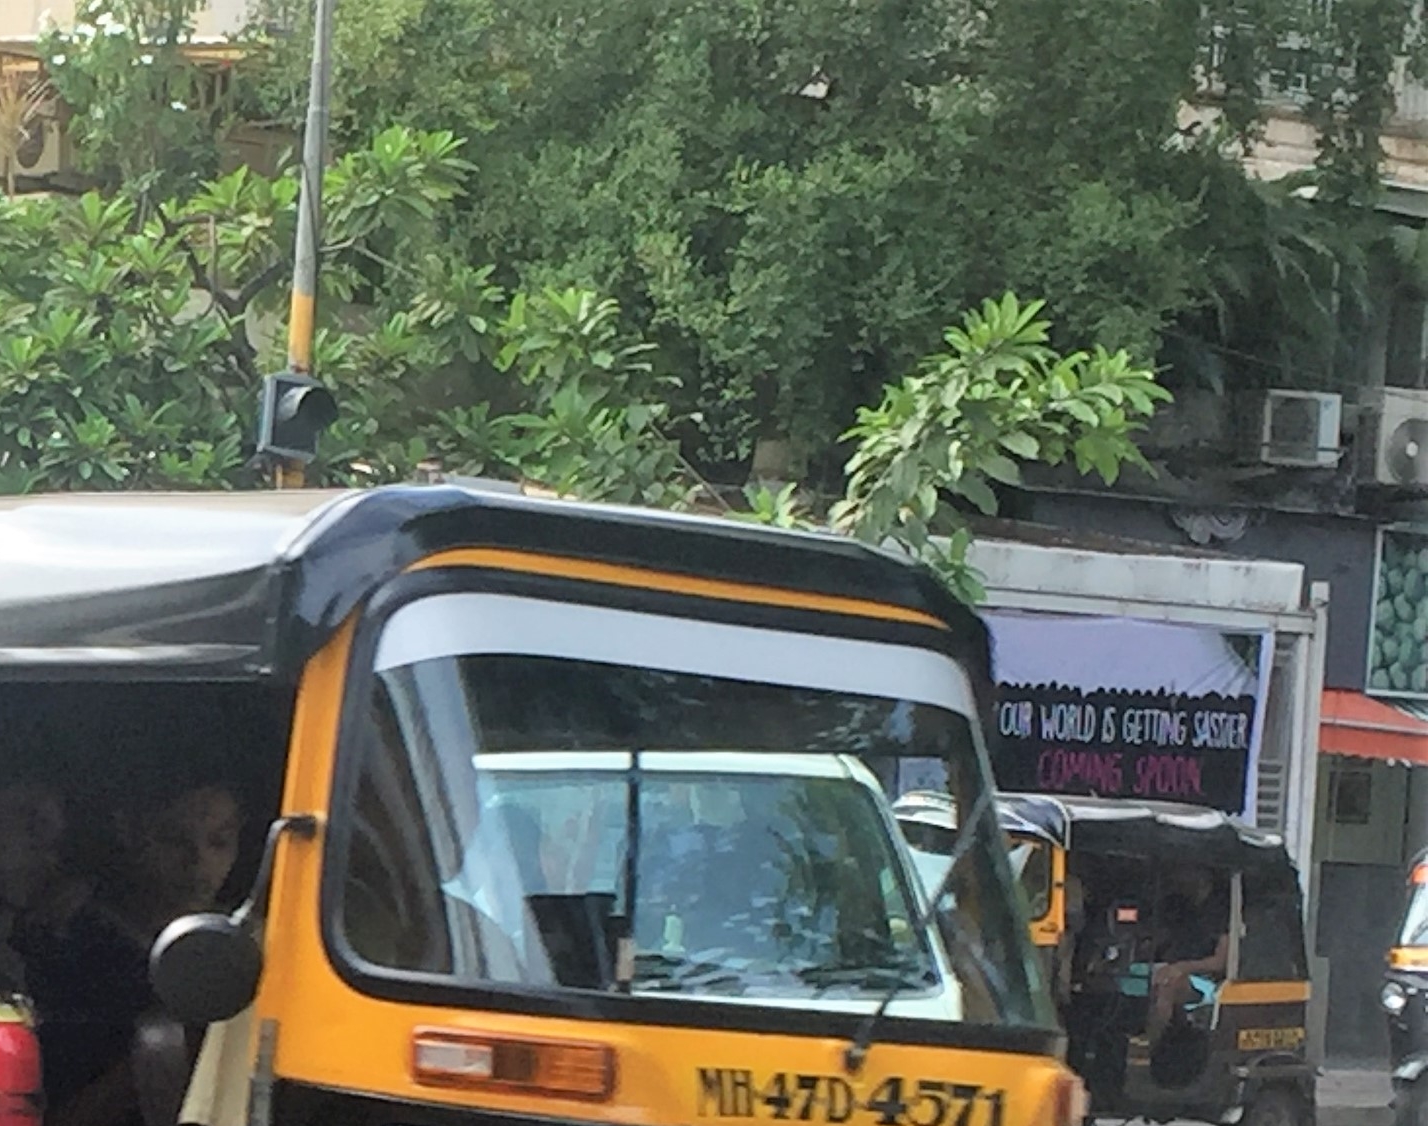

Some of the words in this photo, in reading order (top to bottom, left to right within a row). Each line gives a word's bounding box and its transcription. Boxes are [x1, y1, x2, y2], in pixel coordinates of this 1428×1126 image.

[1000, 701, 1033, 738] OUR
[1040, 703, 1097, 744] WORLD
[1100, 706, 1117, 744] IS
[1121, 708, 1188, 746] GETTING
[1037, 749, 1123, 793] COMING
